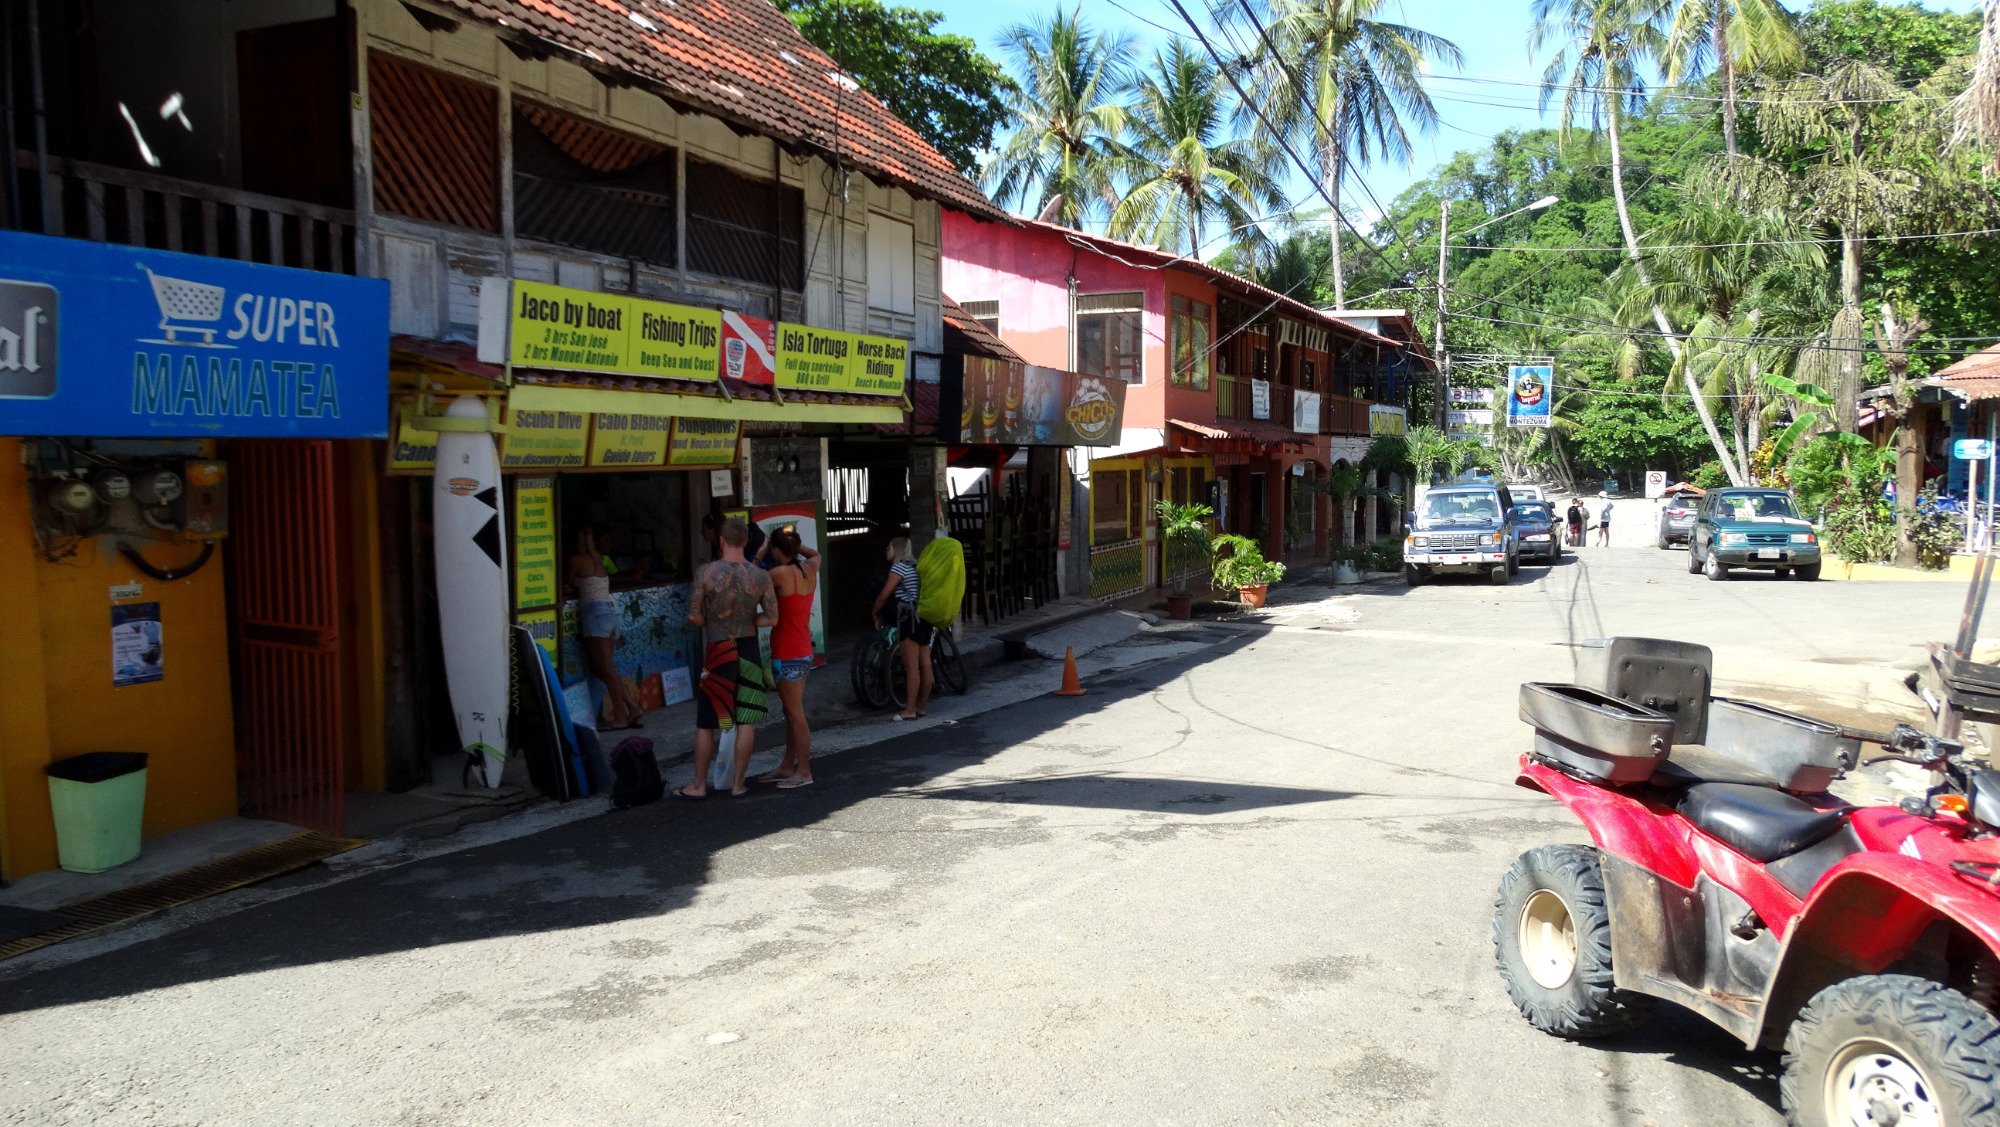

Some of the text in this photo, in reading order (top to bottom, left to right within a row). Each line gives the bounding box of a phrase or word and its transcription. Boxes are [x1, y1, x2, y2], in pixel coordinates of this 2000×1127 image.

[227, 293, 340, 348] SUPER
[521, 292, 622, 331] Jaco by boat
[544, 328, 551, 343] 3
[552, 330, 567, 345] hrs
[570, 331, 587, 348] San
[642, 312, 716, 349] Fishing Trips
[783, 329, 804, 353] Isla
[807, 332, 848, 359] Tortuga
[857, 340, 905, 361] Horse Back
[523, 343, 619, 367] 2 hrs Manuel Antonio
[641, 351, 714, 371] Deep Sea and Coast
[785, 359, 798, 371] Full
[799, 360, 811, 373] day
[866, 359, 894, 377] Riding
[132, 351, 341, 418] MAMATEA
[516, 410, 582, 429] Scuba Dive
[598, 413, 670, 431] Cabo Blanco
[1067, 401, 1116, 424] CHICOS
[678, 417, 737, 435] Bungalows
[603, 449, 631, 463] Guide
